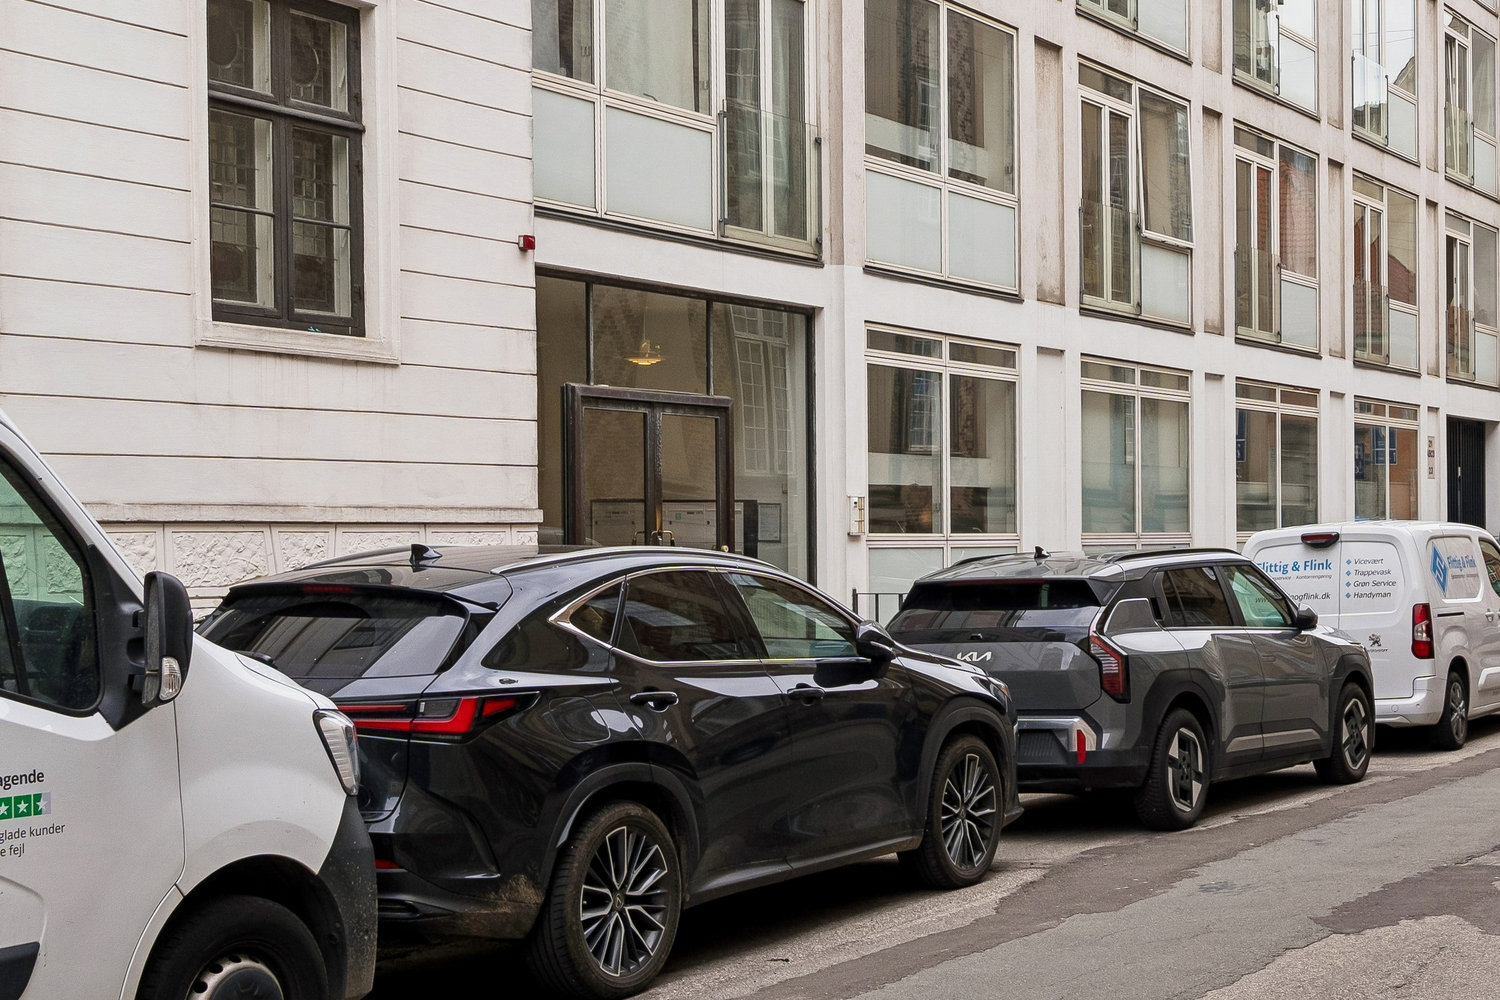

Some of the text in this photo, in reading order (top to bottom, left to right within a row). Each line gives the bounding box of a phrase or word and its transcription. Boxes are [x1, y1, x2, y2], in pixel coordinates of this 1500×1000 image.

[1291, 560, 1300, 572] &
[1304, 559, 1332, 571] Flink
[1354, 568, 1392, 577] Trappevask
[1353, 579, 1397, 588] Grøn Service
[1353, 591, 1392, 600] Handyman
[956, 651, 992, 662] KIA
[29, 823, 66, 838] kunder
[9, 843, 25, 858] fejl
